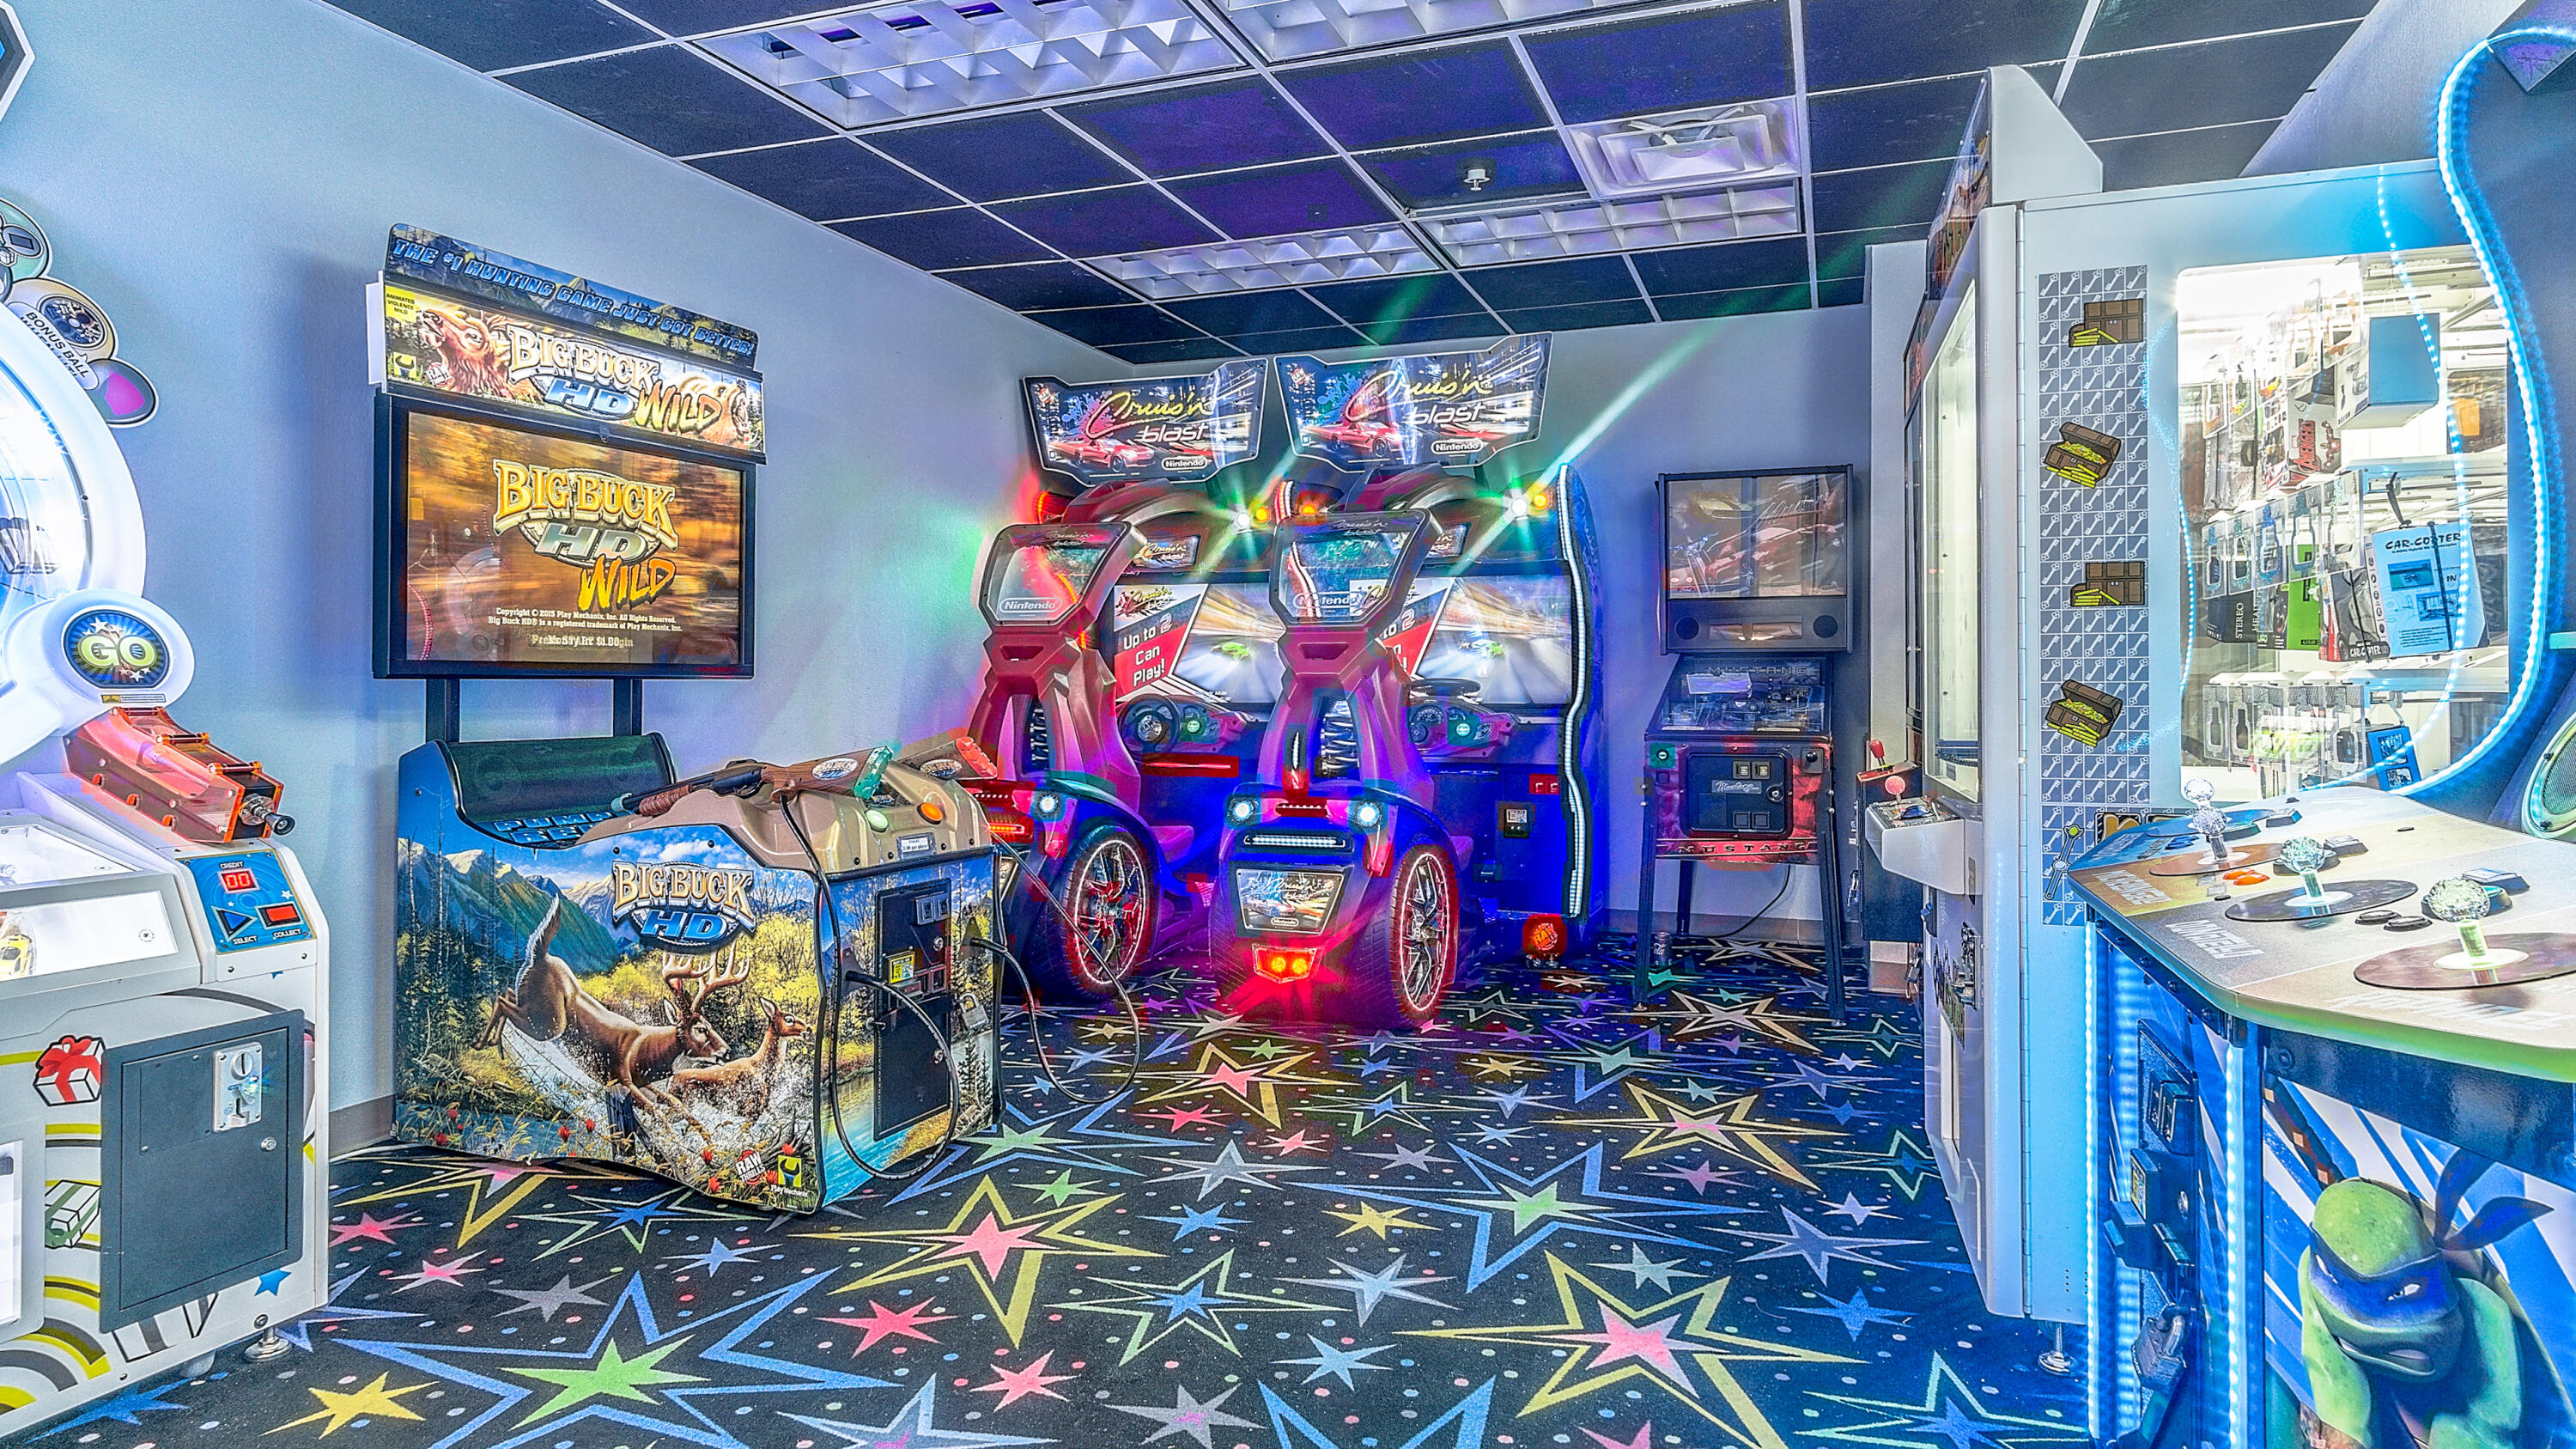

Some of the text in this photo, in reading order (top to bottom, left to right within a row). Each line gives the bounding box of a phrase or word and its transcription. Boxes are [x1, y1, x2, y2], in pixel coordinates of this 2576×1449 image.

[386, 293, 415, 304] ANIMATED
[387, 299, 415, 310] VIOLENCE
[392, 238, 755, 358] THE #1 HUNTING GAME JUST GOT BETTER!
[393, 307, 409, 315] MILD
[25, 311, 66, 350] BONUS
[63, 350, 89, 378] BALL
[507, 325, 660, 396] BIG BUCK
[1346, 368, 1492, 421] Cruis'n
[544, 376, 722, 435] HD WILD
[1085, 391, 1215, 439] Cruis'n
[1409, 401, 1486, 423] blast
[1139, 422, 1210, 443] blast
[1435, 441, 1479, 452] Nintendo
[1164, 458, 1205, 468] Nintendo
[495, 460, 676, 540] BIG BUCK
[536, 522, 648, 560] HD
[577, 555, 677, 612] WILD
[495, 606, 531, 618] Copyright
[556, 610, 573, 620] Play
[573, 611, 605, 620] Mechanix,
[606, 612, 618, 621] Inc.
[629, 613, 648, 624] Rights
[648, 615, 677, 624] Reserved.
[1004, 600, 1057, 611] Nintendo
[488, 616, 501, 626] Big
[501, 617, 521, 626] Buck
[552, 619, 586, 629] registered
[586, 621, 618, 630] trademark
[619, 621, 626, 630] of
[626, 622, 641, 632] Play
[641, 623, 671, 632] Mechanix,
[671, 624, 683, 632] Inc.
[1401, 608, 1415, 631] 2
[2234, 601, 2245, 639] STEREO
[1123, 612, 1173, 650] Up to 2
[77, 633, 159, 668] GO
[1134, 645, 1161, 666] Can
[1133, 657, 1166, 687] Play!
[494, 811, 614, 832] PUMP
[1678, 842, 1807, 853] MUSTANG
[219, 861, 245, 869] CREDIT
[226, 873, 251, 888] 00
[614, 861, 756, 923] BIG BUCK
[273, 928, 302, 939] COLLECT
[641, 909, 728, 940] HD
[233, 935, 258, 945] SELECT
[735, 1151, 764, 1175] RAW
[739, 1163, 766, 1184] THRILLS
[770, 1184, 809, 1197] Play Mechanix
